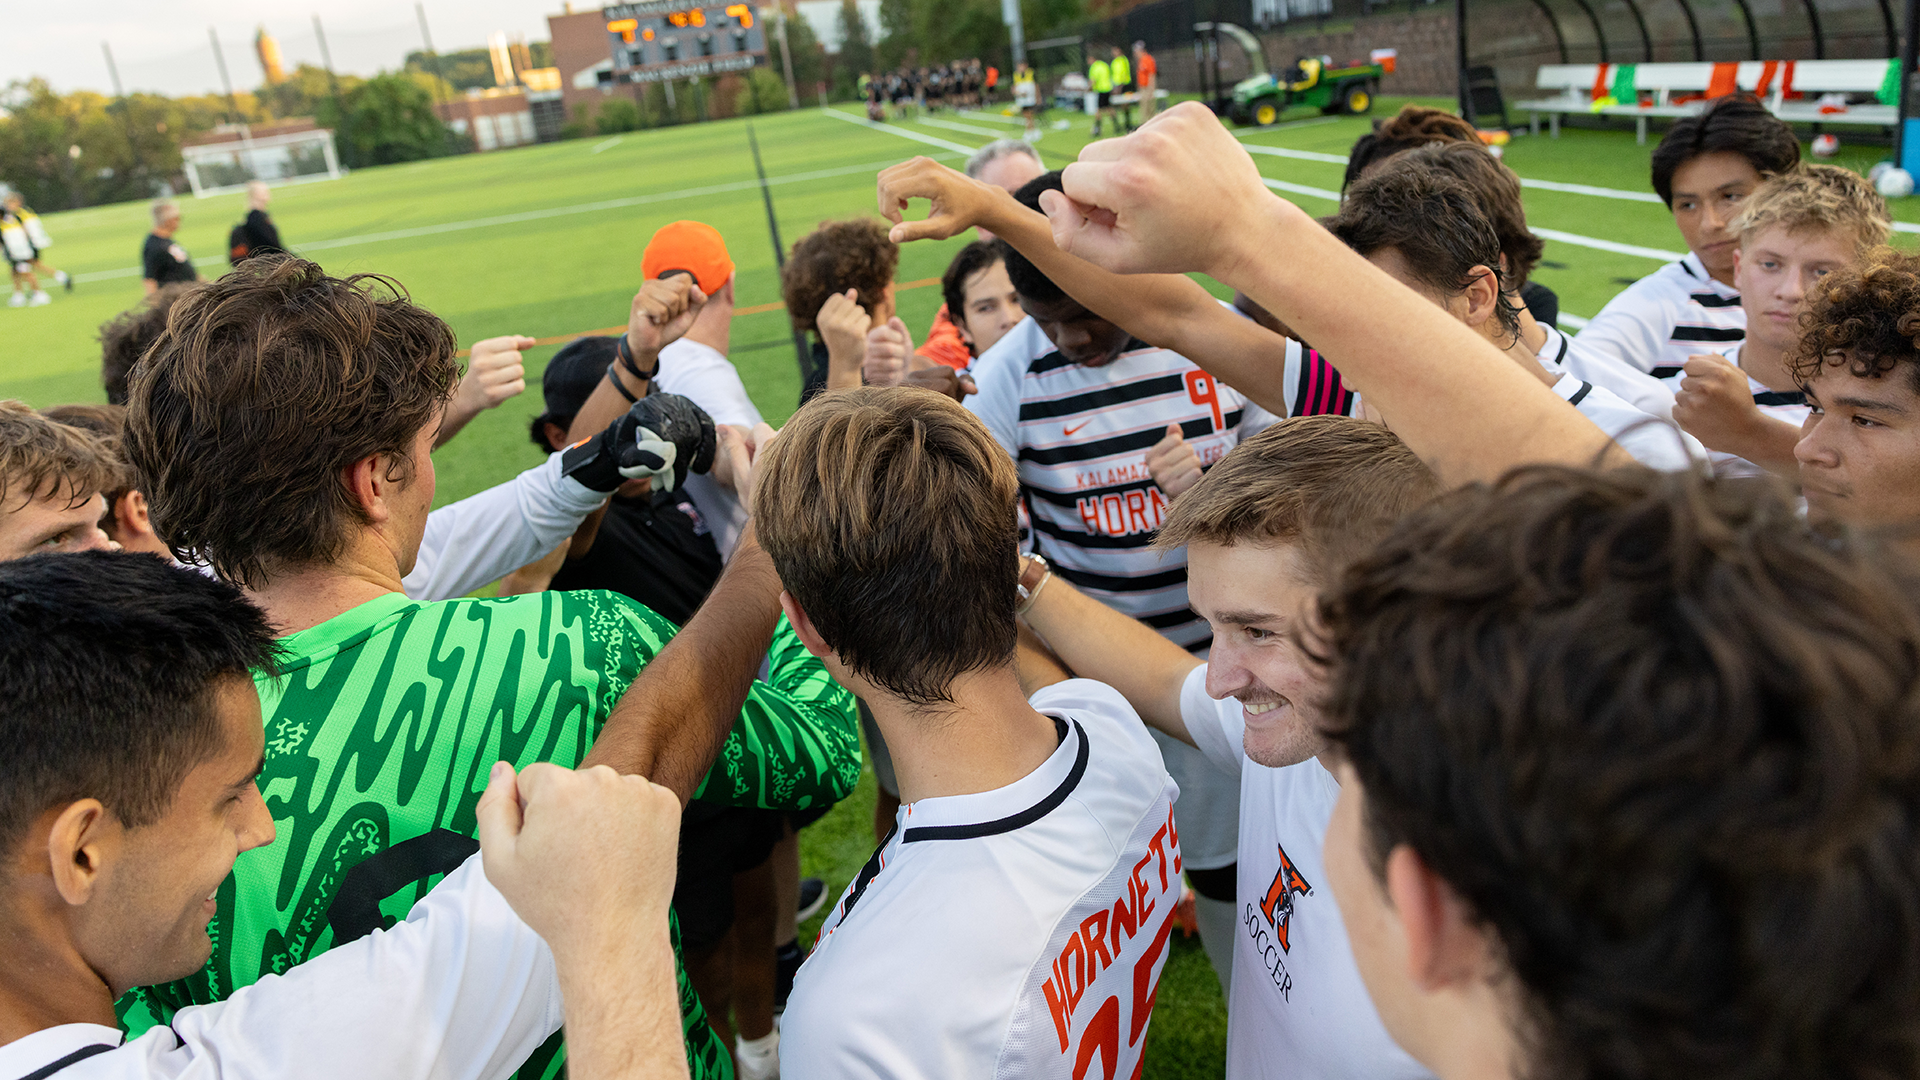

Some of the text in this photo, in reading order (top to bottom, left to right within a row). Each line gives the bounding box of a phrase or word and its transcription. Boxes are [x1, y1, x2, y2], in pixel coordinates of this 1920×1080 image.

[1185, 369, 1223, 431] 9
[1076, 461, 1152, 490] KALAMAZ
[1077, 487, 1167, 536] HORN
[1244, 902, 1293, 1004] SOCCER
